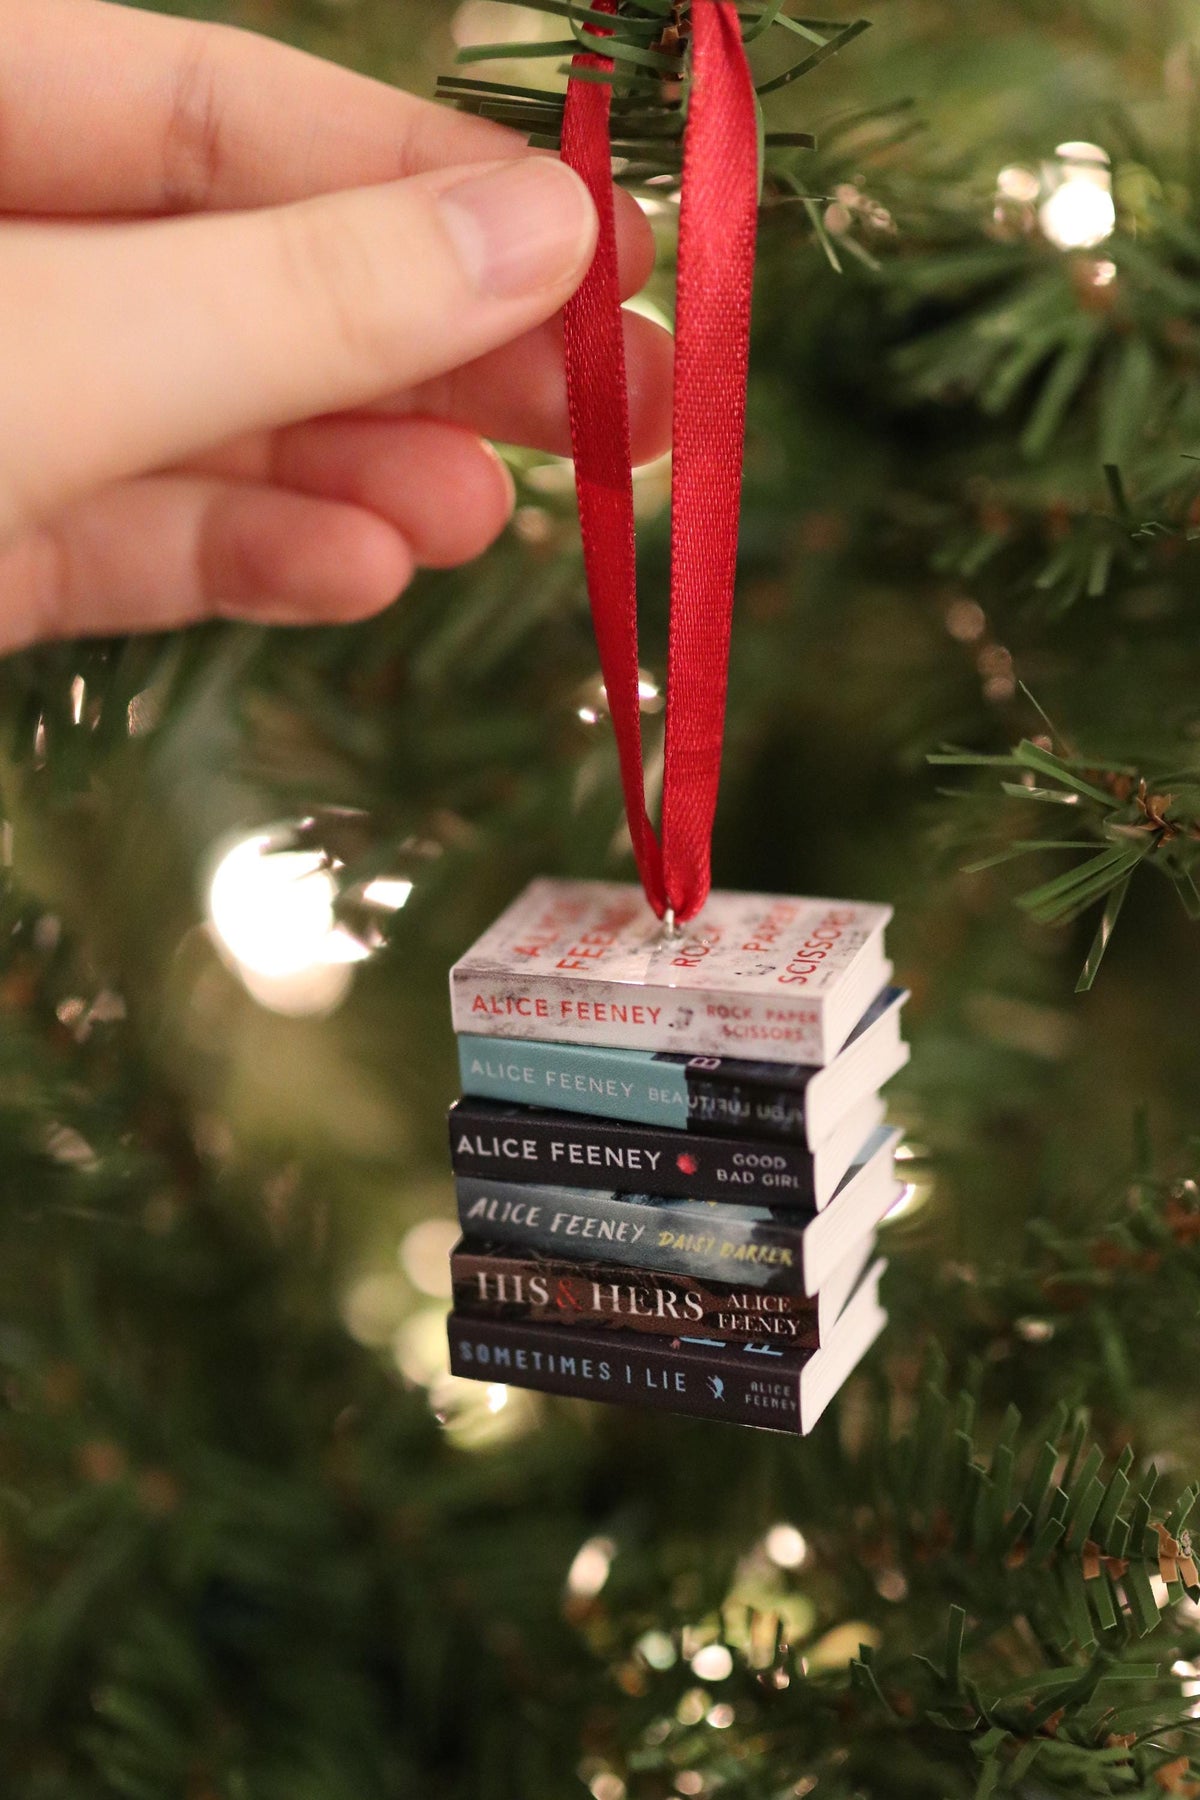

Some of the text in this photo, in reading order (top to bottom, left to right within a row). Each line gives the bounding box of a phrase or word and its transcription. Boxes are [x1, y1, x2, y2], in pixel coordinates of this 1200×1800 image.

[778, 908, 856, 985] SCISSO
[472, 993, 662, 1026] ALICE FEENEY
[706, 1004, 819, 1024] ROCK PAPER
[722, 1024, 805, 1042] SCISSORS
[471, 1058, 537, 1084] ALICE
[545, 1071, 634, 1098] FEENEY
[457, 1134, 661, 1171] ALICE FEENEY
[732, 1153, 788, 1170] GOOD
[716, 1169, 800, 1189] BAD GIRL
[467, 1196, 542, 1227] ALICE
[549, 1212, 646, 1244] FEENEY
[657, 1230, 717, 1256] DAISY
[478, 1271, 705, 1322] HIS & HERS
[726, 1292, 792, 1314] ALICE
[717, 1313, 801, 1336] FEENEY
[459, 1340, 612, 1381] SOMETIMES
[645, 1367, 687, 1393] LIE
[750, 1381, 792, 1398] ALICE
[744, 1394, 798, 1412] FEENEY
